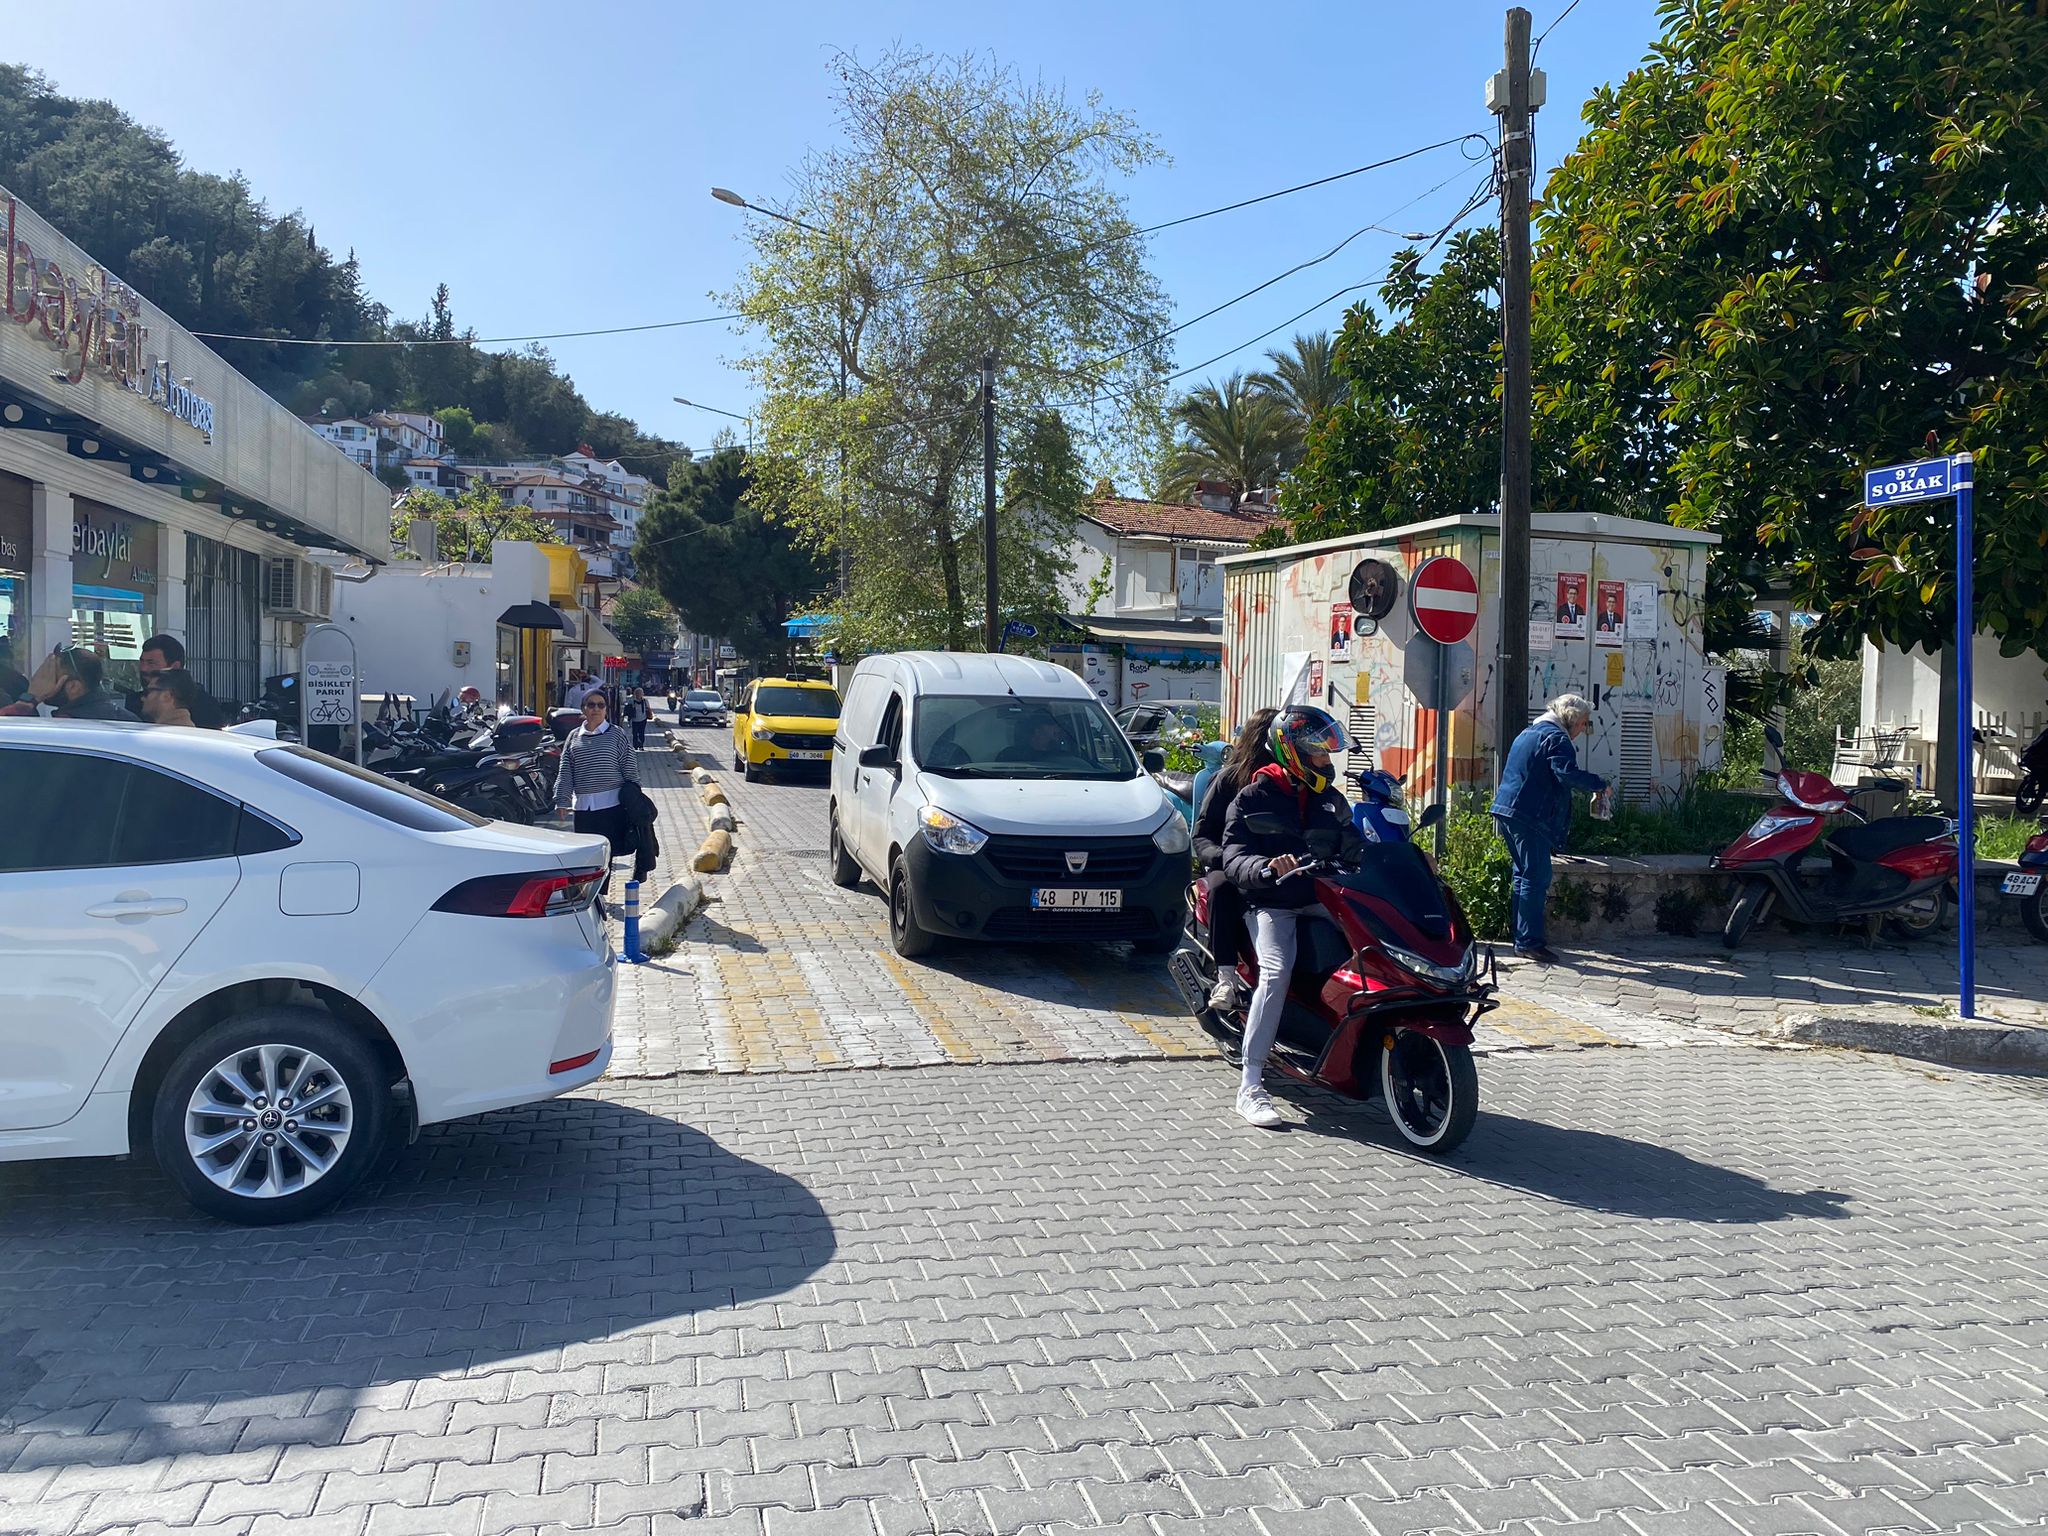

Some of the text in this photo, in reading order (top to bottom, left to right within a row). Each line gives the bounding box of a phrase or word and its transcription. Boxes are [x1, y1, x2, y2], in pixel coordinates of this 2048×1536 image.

[1895, 466, 1919, 480] 97
[1871, 474, 1944, 498] SOKAK
[307, 680, 352, 688] BİSİKLET
[2007, 874, 2038, 885] 48 ACA
[2009, 884, 2026, 893] 171
[1040, 890, 1056, 906] 48
[1099, 891, 1117, 906] 115
